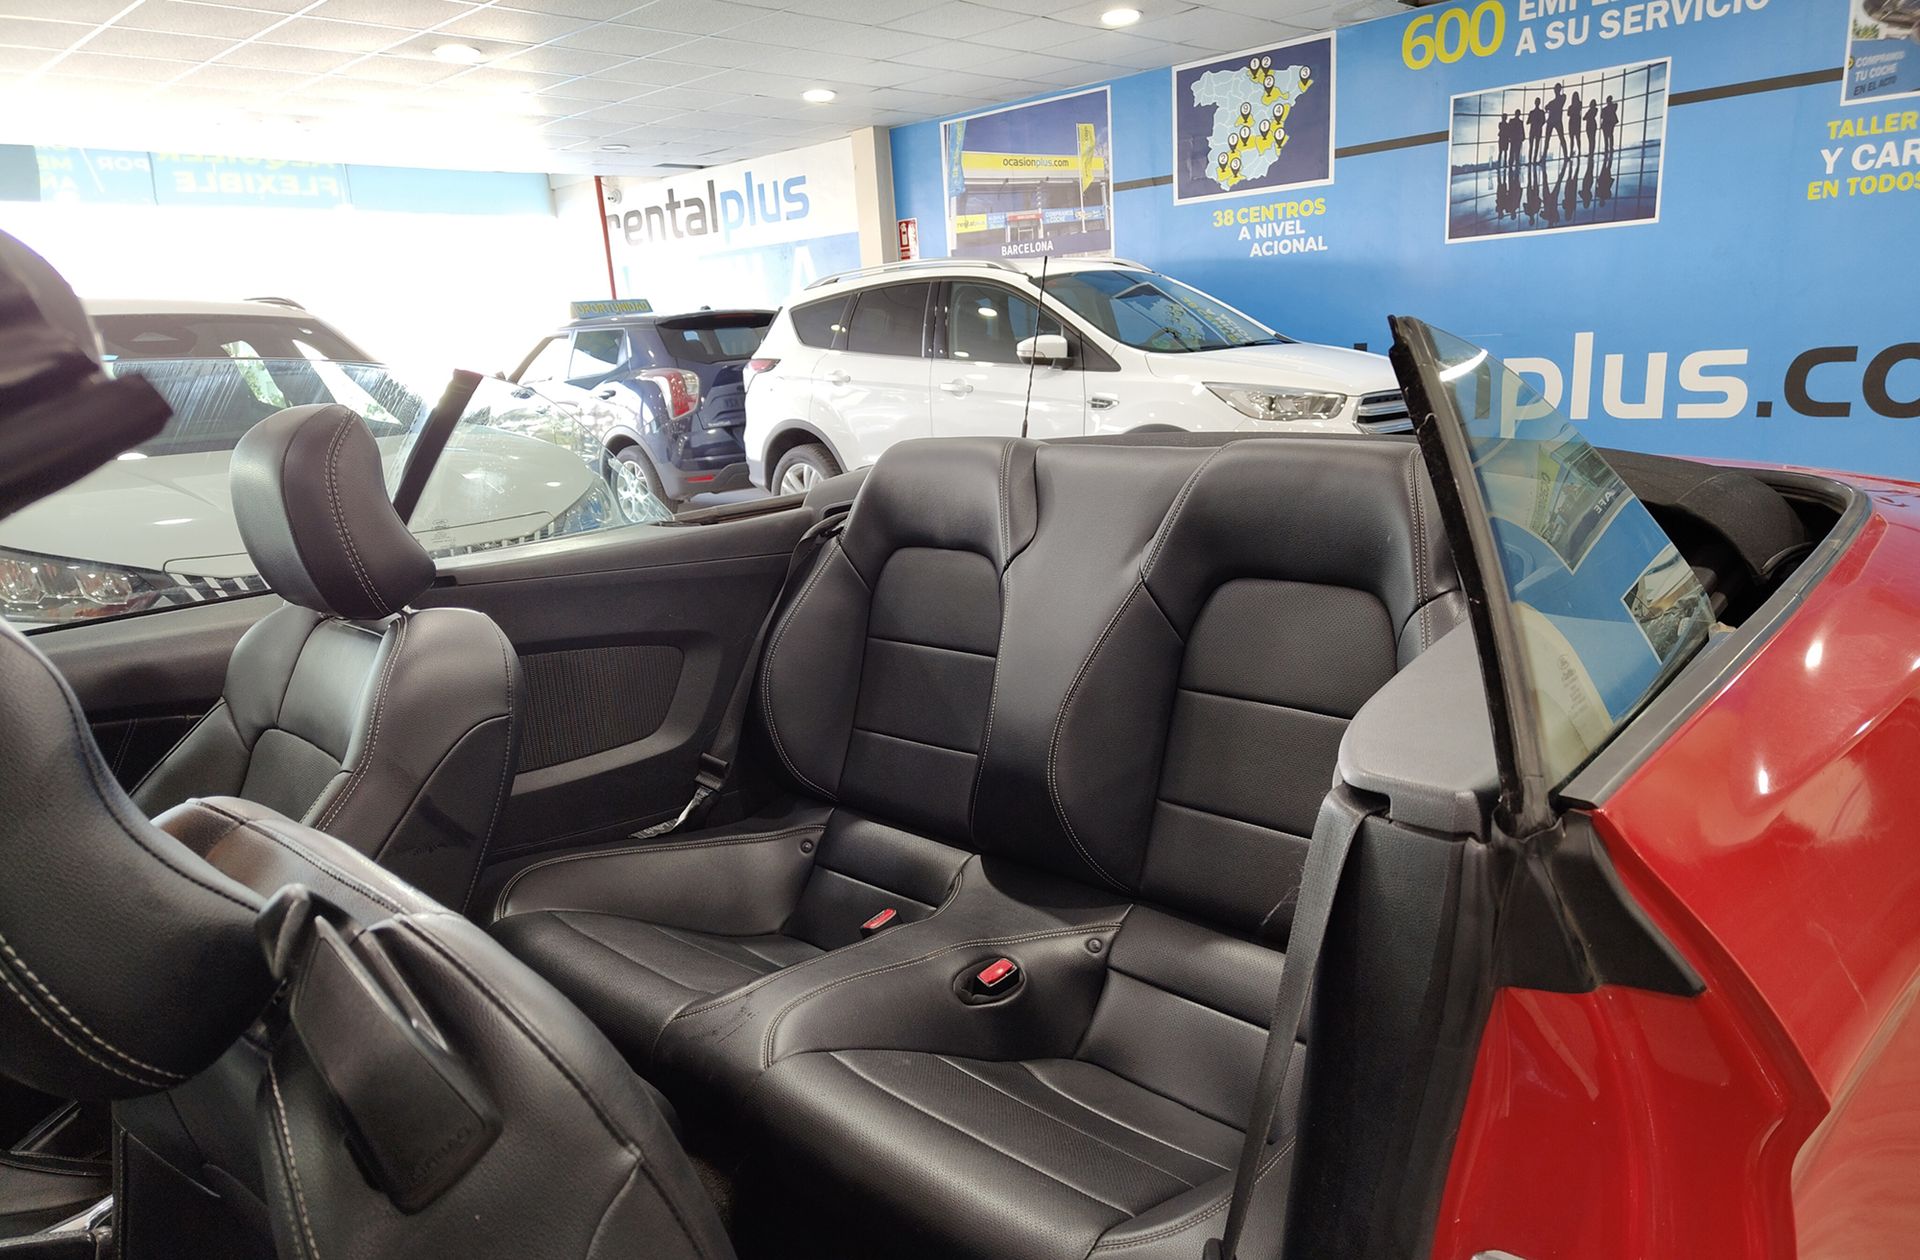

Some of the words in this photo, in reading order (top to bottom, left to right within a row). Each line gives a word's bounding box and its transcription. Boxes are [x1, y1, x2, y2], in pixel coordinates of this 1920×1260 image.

[1402, 0, 1505, 70] 600
[1515, 27, 1537, 56] A
[1544, 15, 1590, 50] SU
[1827, 111, 1918, 139] TALLER
[1003, 157, 1069, 168] ocasionplus.com
[1820, 147, 1844, 174] Y
[1807, 180, 1839, 200] EN
[605, 171, 810, 247] rentalplus
[1213, 209, 1234, 228] 38
[1237, 197, 1326, 224] CENTROS
[1238, 226, 1251, 241] A
[1255, 220, 1306, 239] NIVEL
[1001, 240, 1054, 256] BARCELONA
[1249, 236, 1328, 257] ACIONAL
